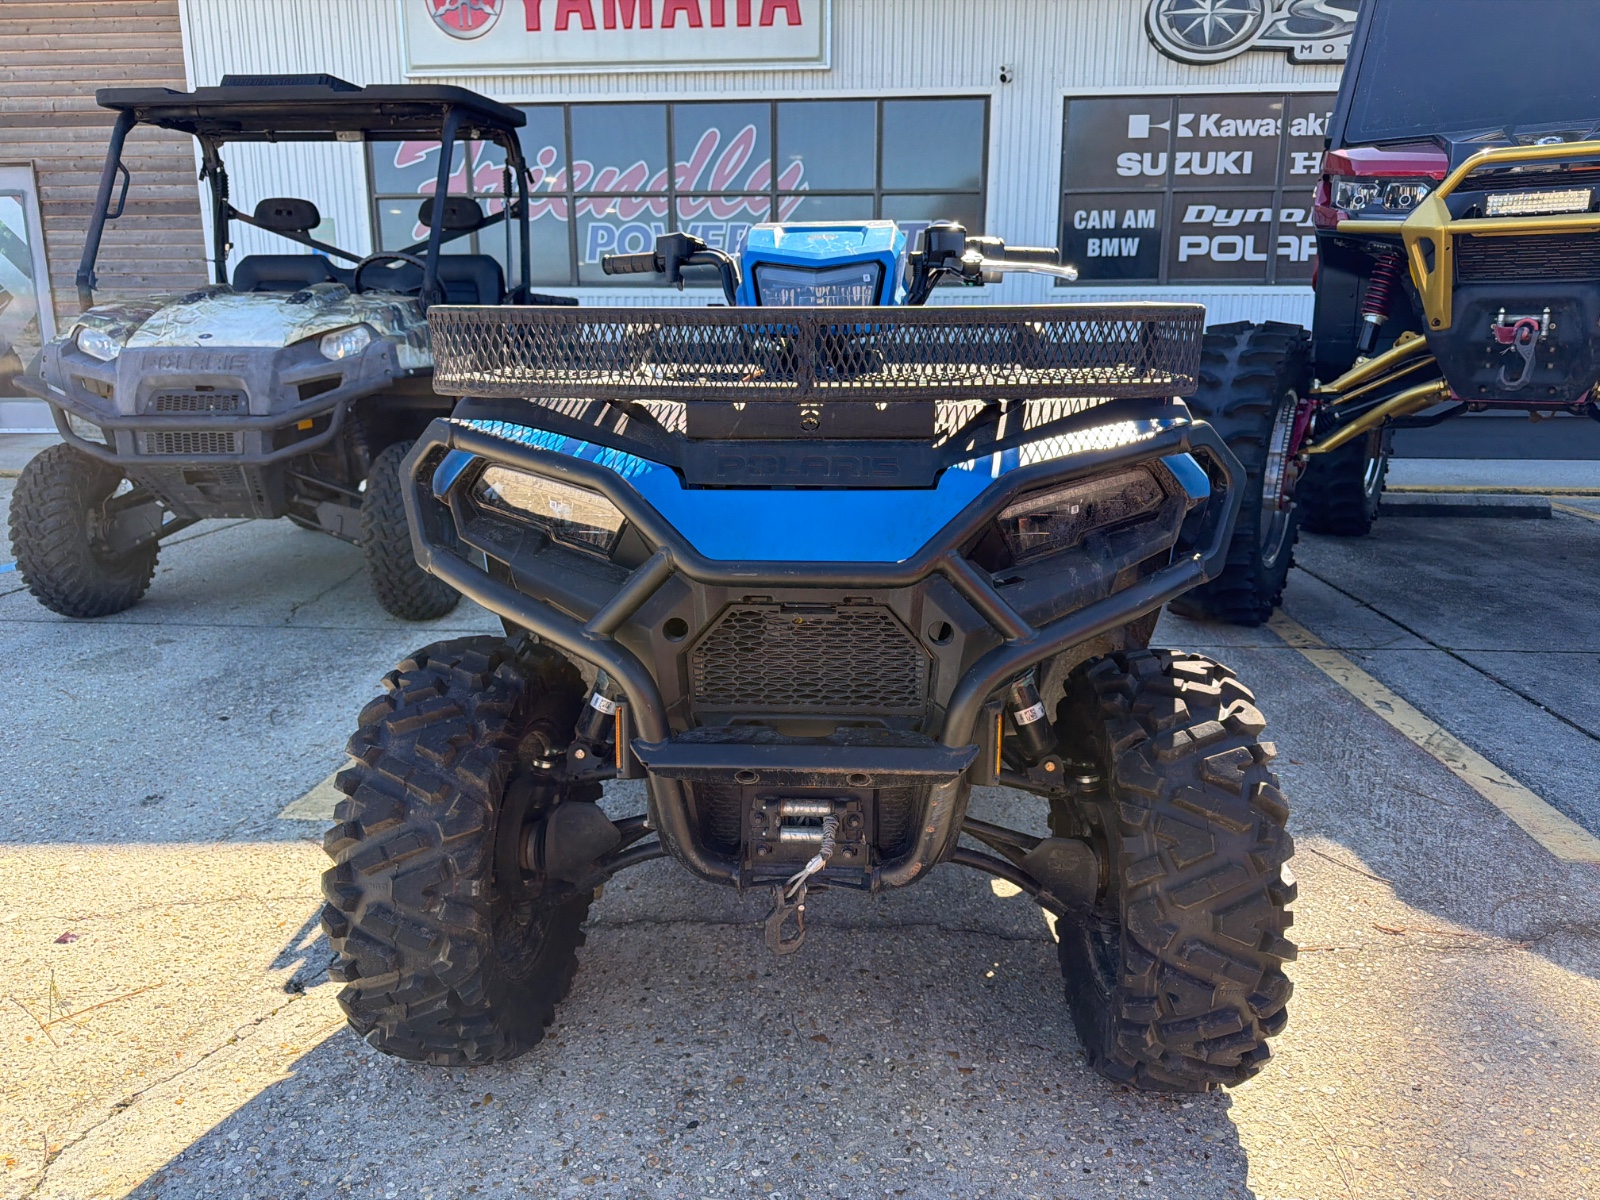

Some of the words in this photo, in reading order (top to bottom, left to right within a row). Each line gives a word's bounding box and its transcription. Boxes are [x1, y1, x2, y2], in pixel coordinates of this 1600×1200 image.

[1198, 112, 1332, 138] Kawasaki
[1116, 151, 1253, 177] SUZUKI
[1073, 209, 1116, 230] CAN
[1121, 209, 1156, 229] AM
[1087, 237, 1140, 258] BMW
[717, 454, 900, 478] POLARIS
